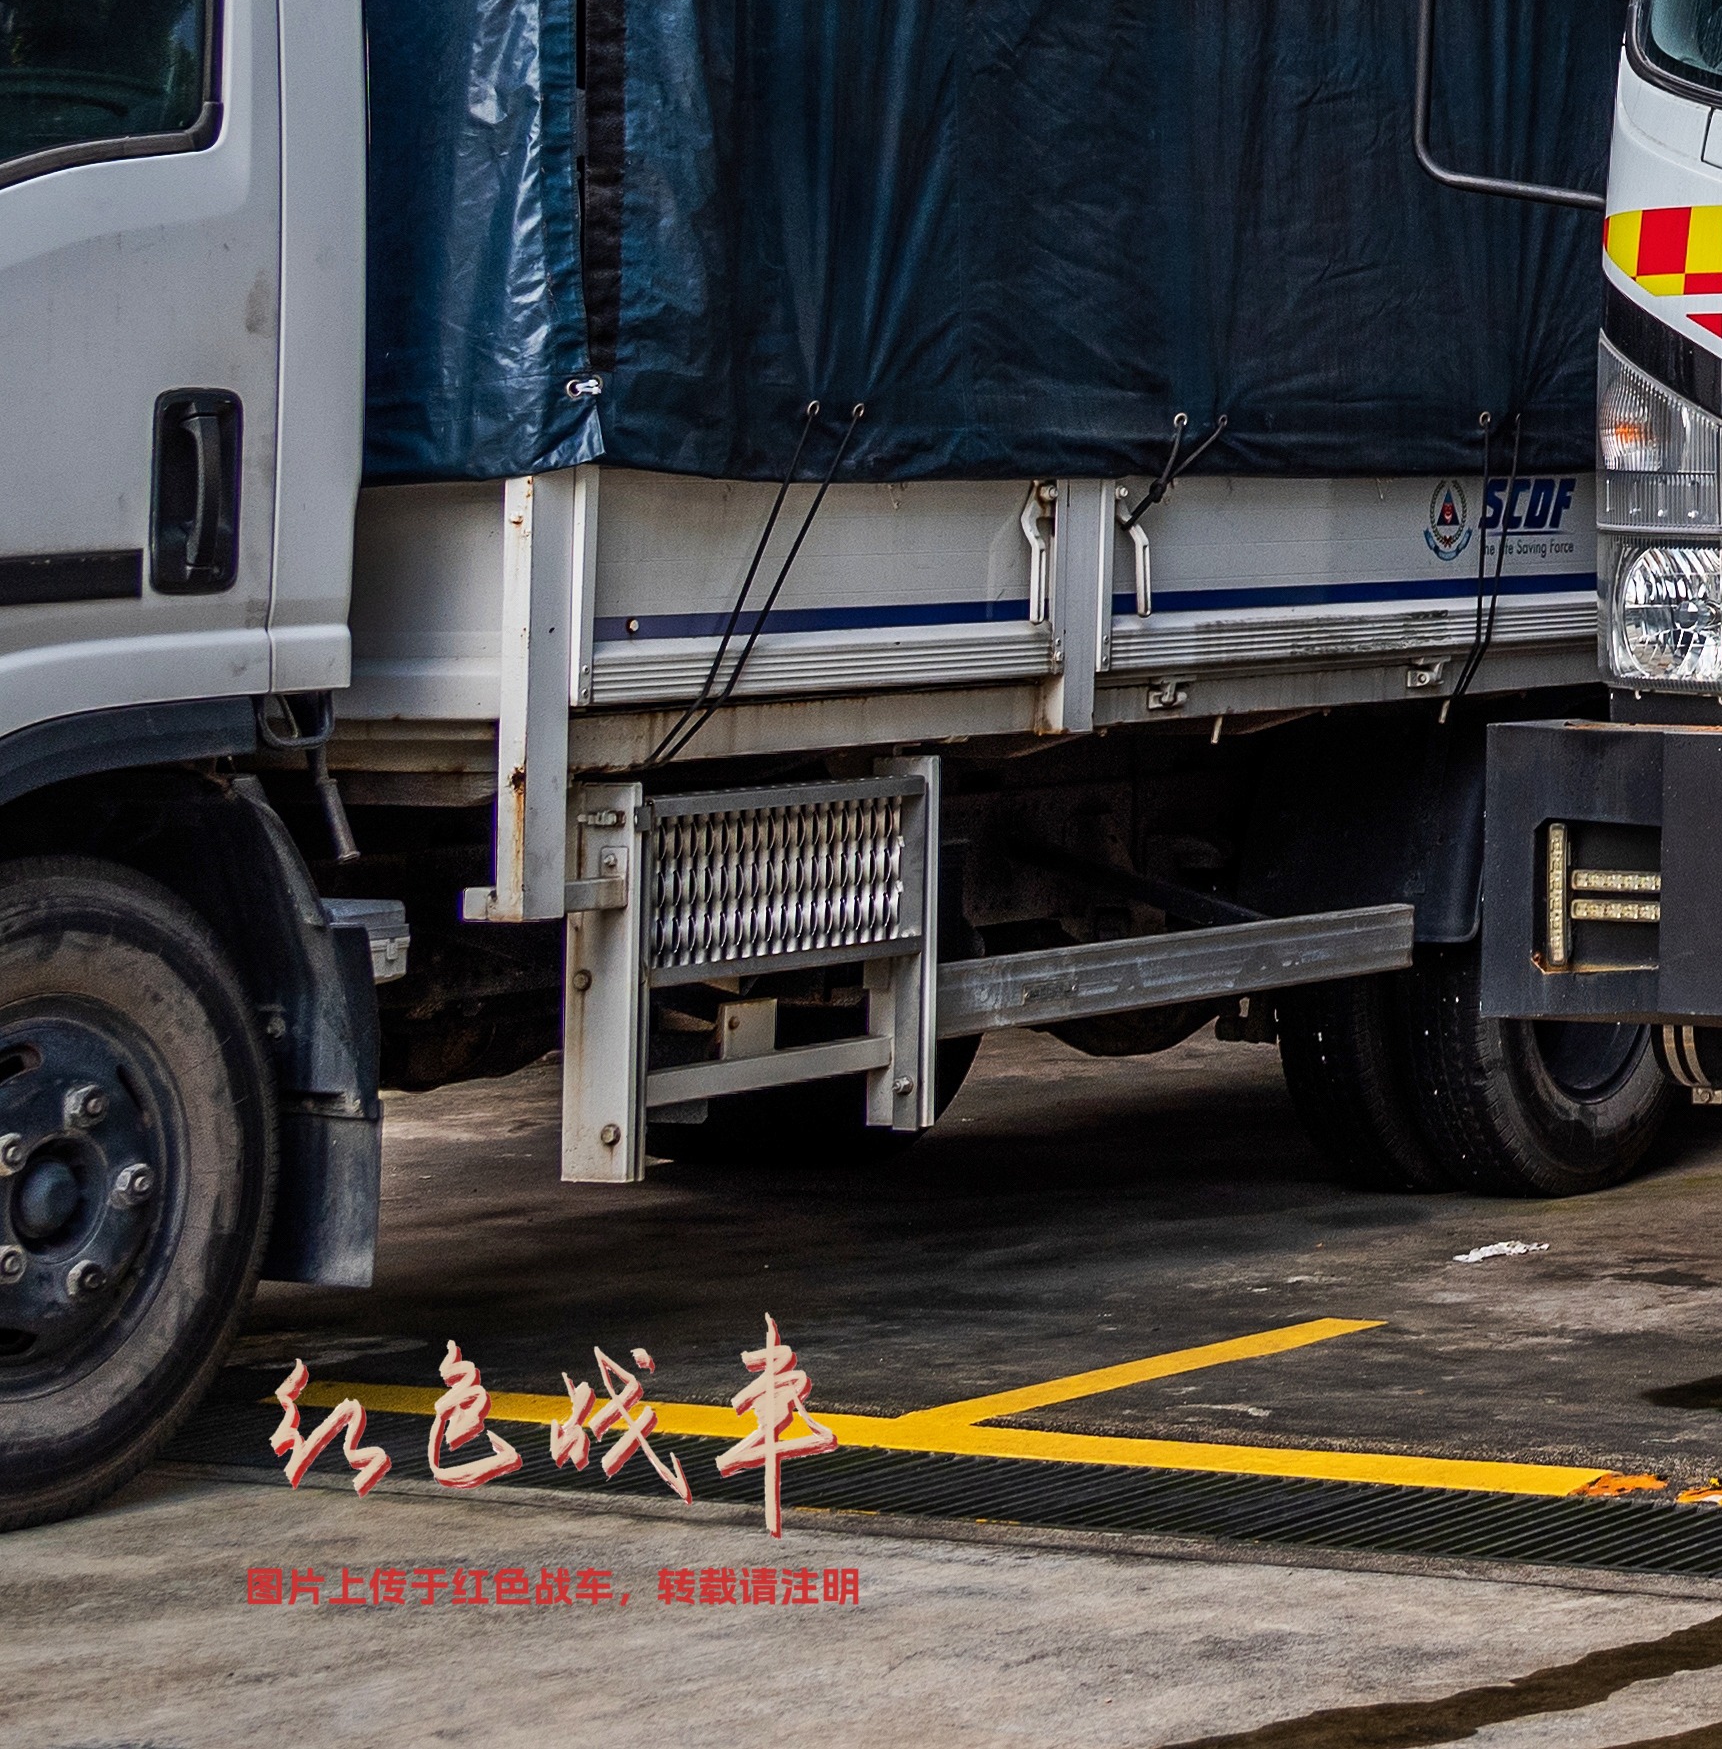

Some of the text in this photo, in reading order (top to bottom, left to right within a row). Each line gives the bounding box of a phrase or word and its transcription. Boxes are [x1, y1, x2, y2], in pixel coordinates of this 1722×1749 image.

[1478, 478, 1577, 530] SCDF
[1516, 539, 1547, 558] Saving
[1549, 538, 1574, 553] Force
